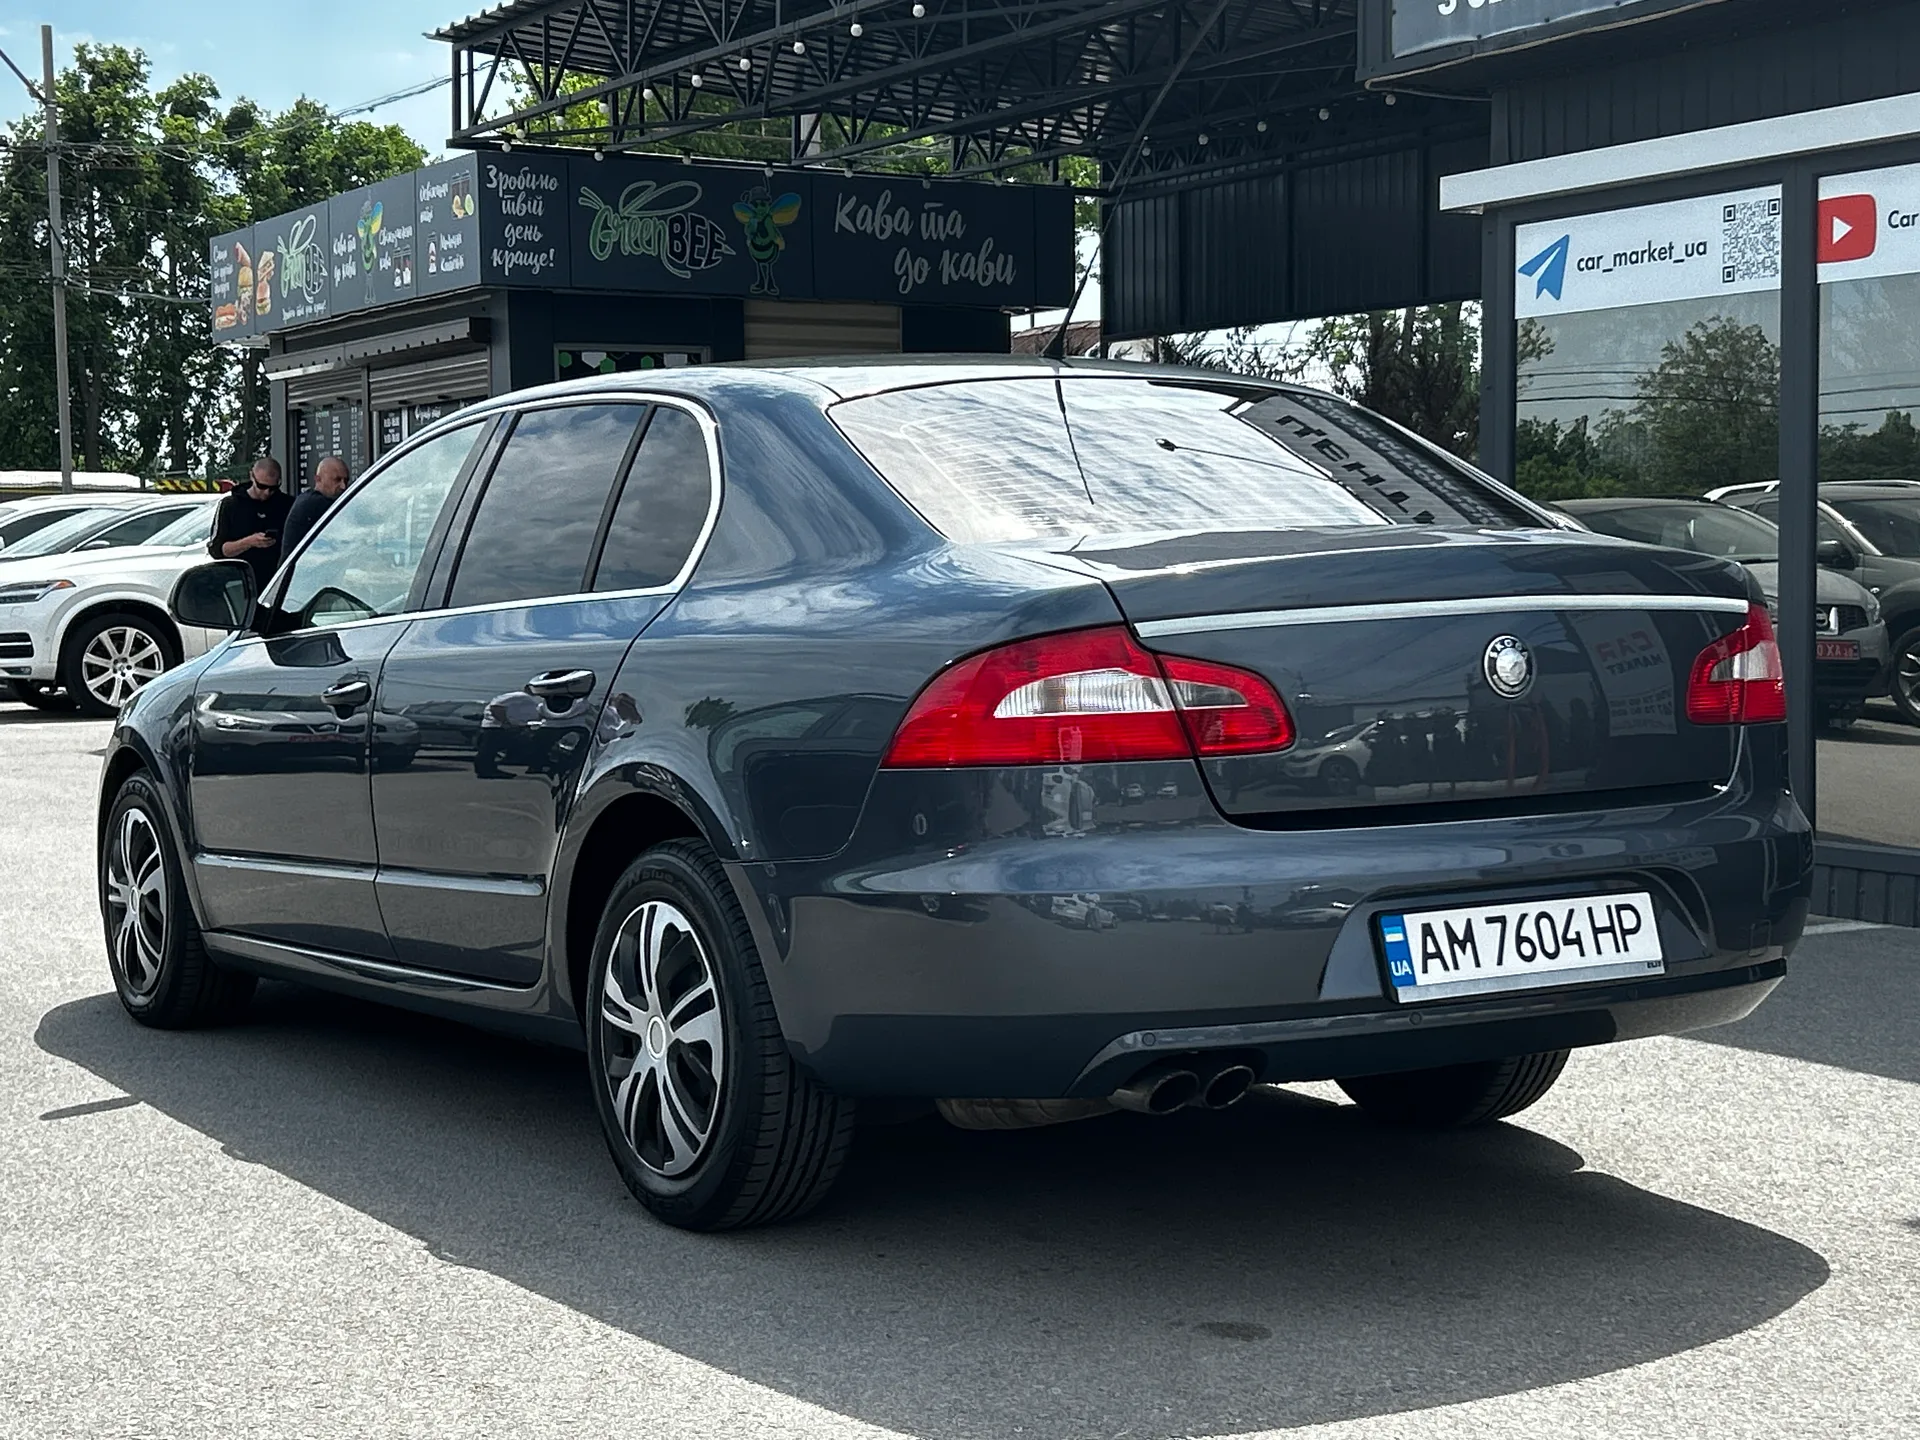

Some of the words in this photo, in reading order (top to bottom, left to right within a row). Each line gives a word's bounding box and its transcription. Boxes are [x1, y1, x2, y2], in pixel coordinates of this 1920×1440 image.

[486, 164, 559, 198] Зробимо
[501, 191, 544, 217] твій
[834, 189, 914, 241] Кава
[920, 202, 967, 242] та
[1888, 210, 1919, 229] Car
[504, 222, 543, 248] день
[490, 248, 555, 276] краще!
[894, 247, 931, 294] до
[938, 237, 1017, 287] кави
[1576, 238, 1708, 273] car_market_ua
[1391, 959, 1412, 977] UA
